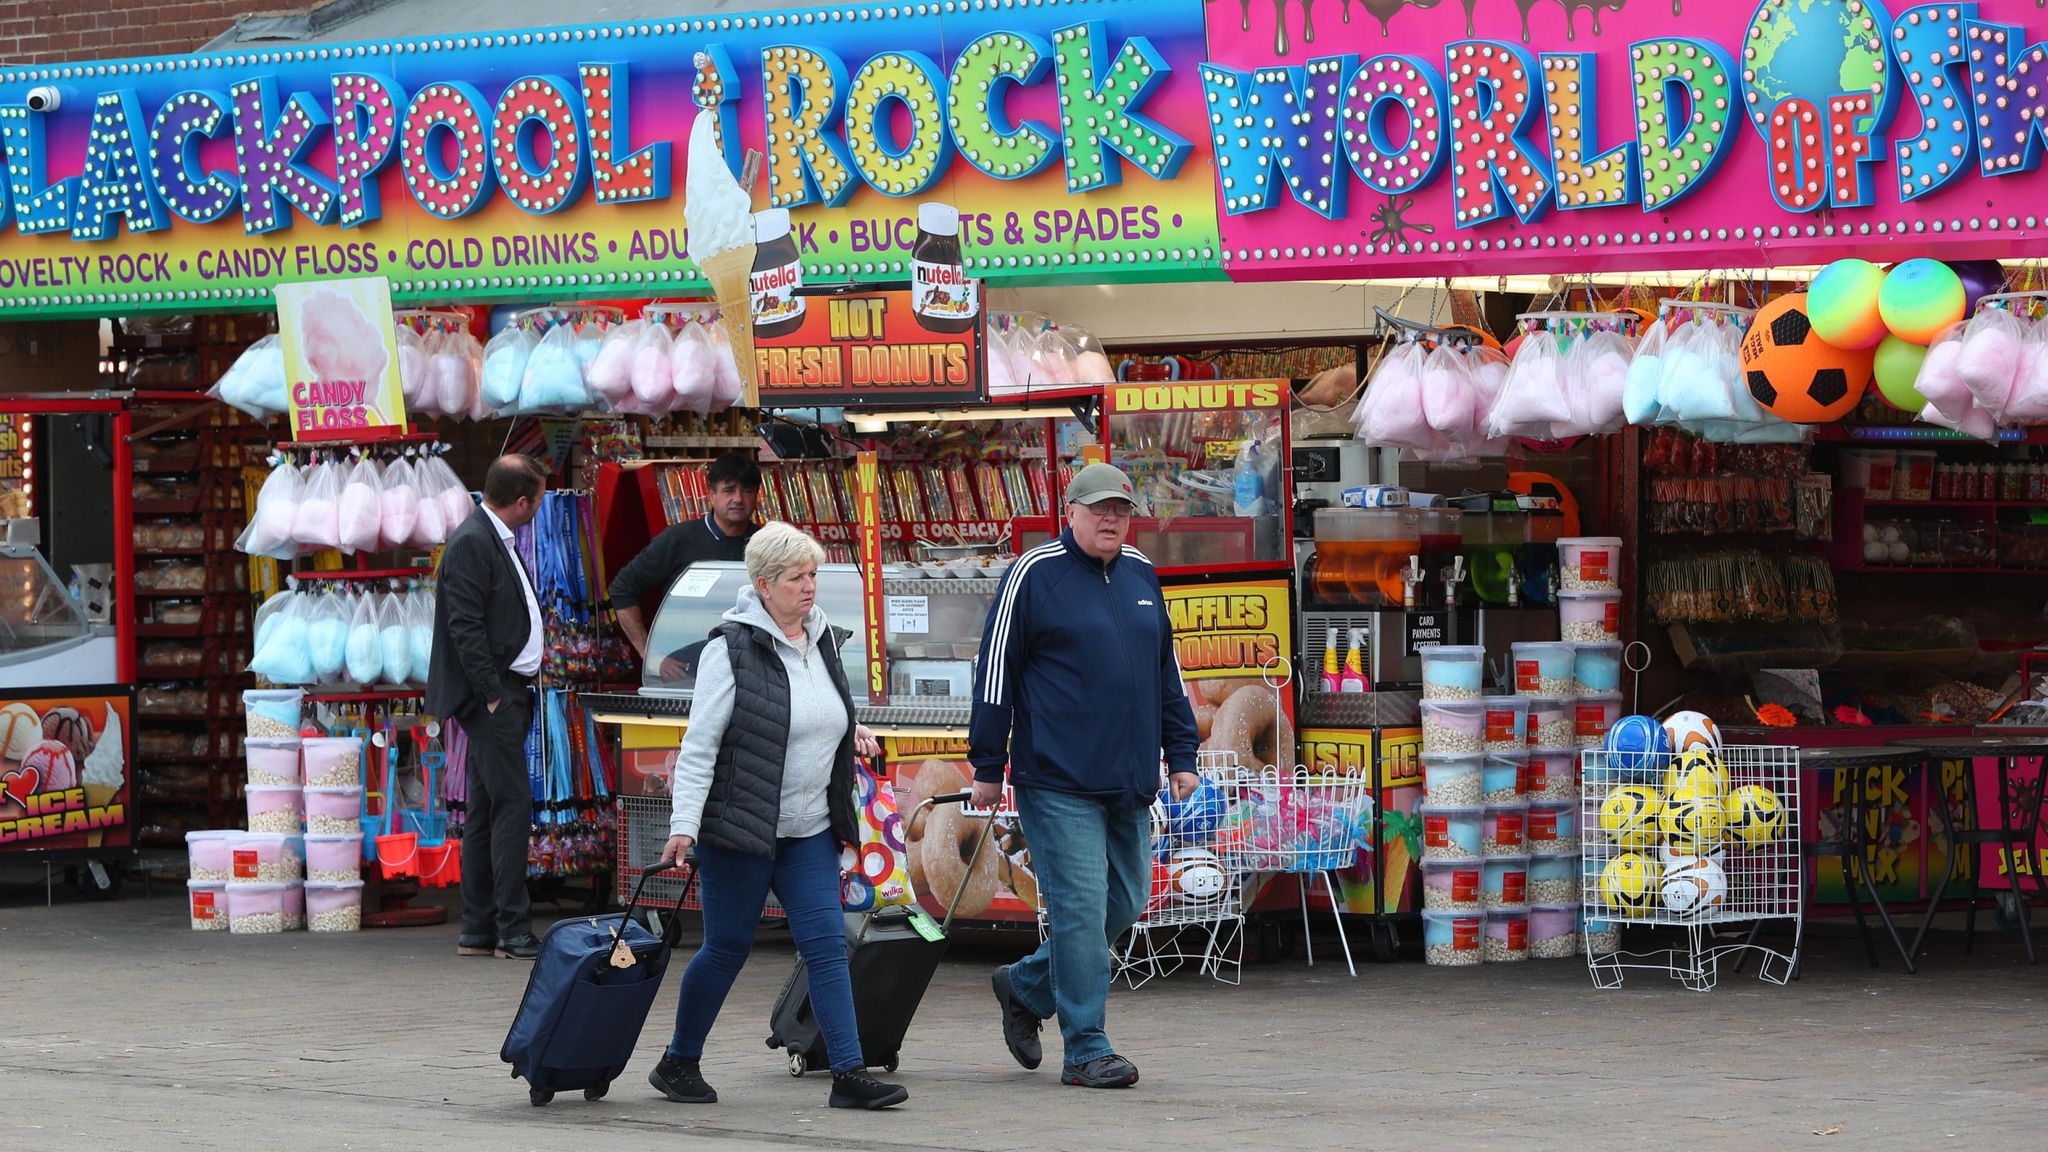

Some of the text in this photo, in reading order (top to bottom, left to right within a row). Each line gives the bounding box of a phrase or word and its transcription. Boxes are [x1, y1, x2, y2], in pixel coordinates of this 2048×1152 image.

[0, 20, 1190, 242] LACKPOOL ROCK
[1200, 38, 1738, 228] WORLD
[1769, 93, 1878, 212] OF
[99, 252, 171, 284] ROCK
[197, 246, 286, 279] CANDY
[295, 242, 378, 275] FLOSS
[407, 237, 483, 270] COLD
[492, 232, 598, 266] DRINKS
[850, 210, 994, 252] BUCTS
[1004, 212, 1024, 245] &
[1033, 205, 1161, 244] SPADES
[830, 298, 887, 340] HOT
[757, 342, 969, 388] FRESH DONUTS
[293, 380, 366, 407] CANDY
[1115, 383, 1280, 411] DONUTS
[297, 405, 369, 431] FLOSS
[957, 522, 1000, 537] EACH
[859, 463, 883, 692] WAFFLES
[1412, 628, 1441, 639] PAYMENTS
[1418, 615, 1434, 626] CARD
[26, 787, 85, 817] ICE
[0, 803, 124, 842] CREAM
[881, 885, 904, 898] wilko
